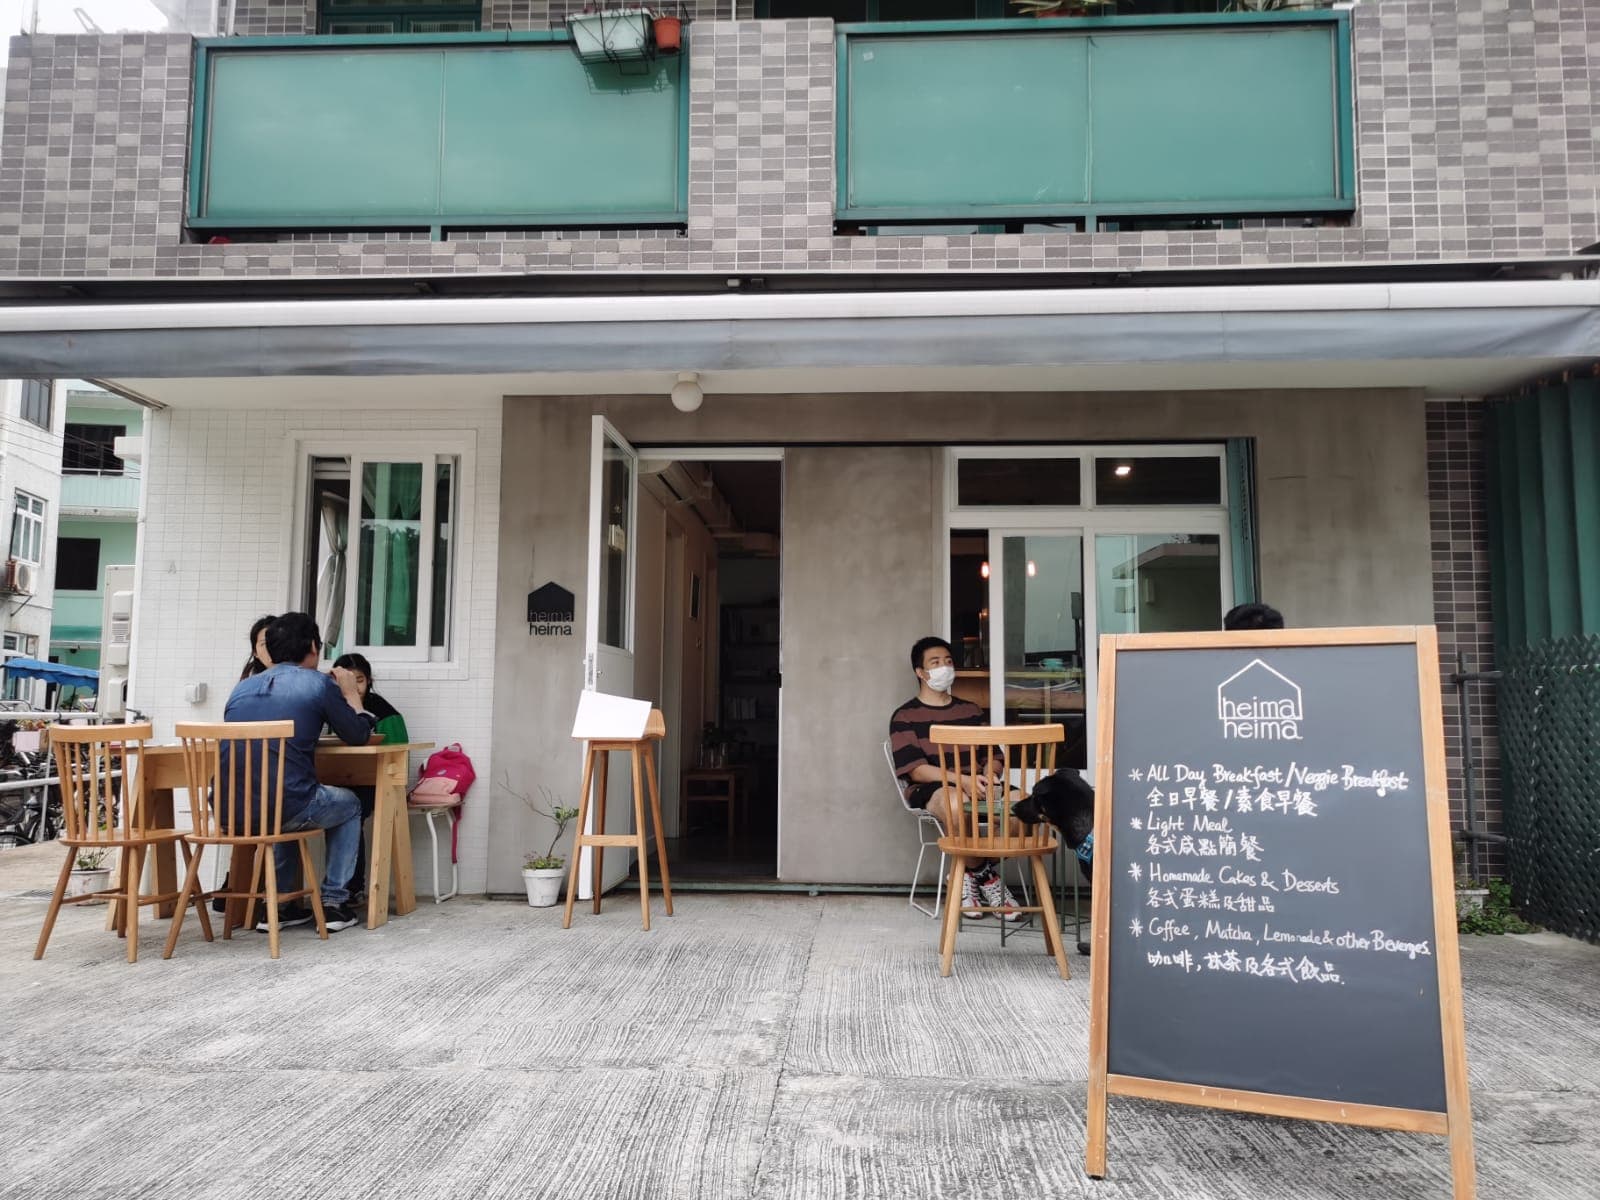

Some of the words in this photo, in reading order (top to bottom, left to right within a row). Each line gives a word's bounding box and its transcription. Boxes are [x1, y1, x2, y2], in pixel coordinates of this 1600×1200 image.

[529, 609, 572, 621] heima
[529, 623, 572, 636] heima
[1222, 696, 1298, 719] heima
[1223, 719, 1303, 740] heima
[1174, 764, 1207, 787] Day
[1212, 763, 1283, 789] Breakfast
[1341, 765, 1409, 797] Breakfast
[1147, 811, 1184, 837] Light
[1193, 815, 1233, 833] Meal
[1150, 862, 1214, 884] Homemade
[1218, 865, 1257, 887] Cakes
[1260, 871, 1279, 892] &
[1281, 868, 1340, 894] Desserts
[1146, 887, 1275, 912] 各式蛋糕及甜品
